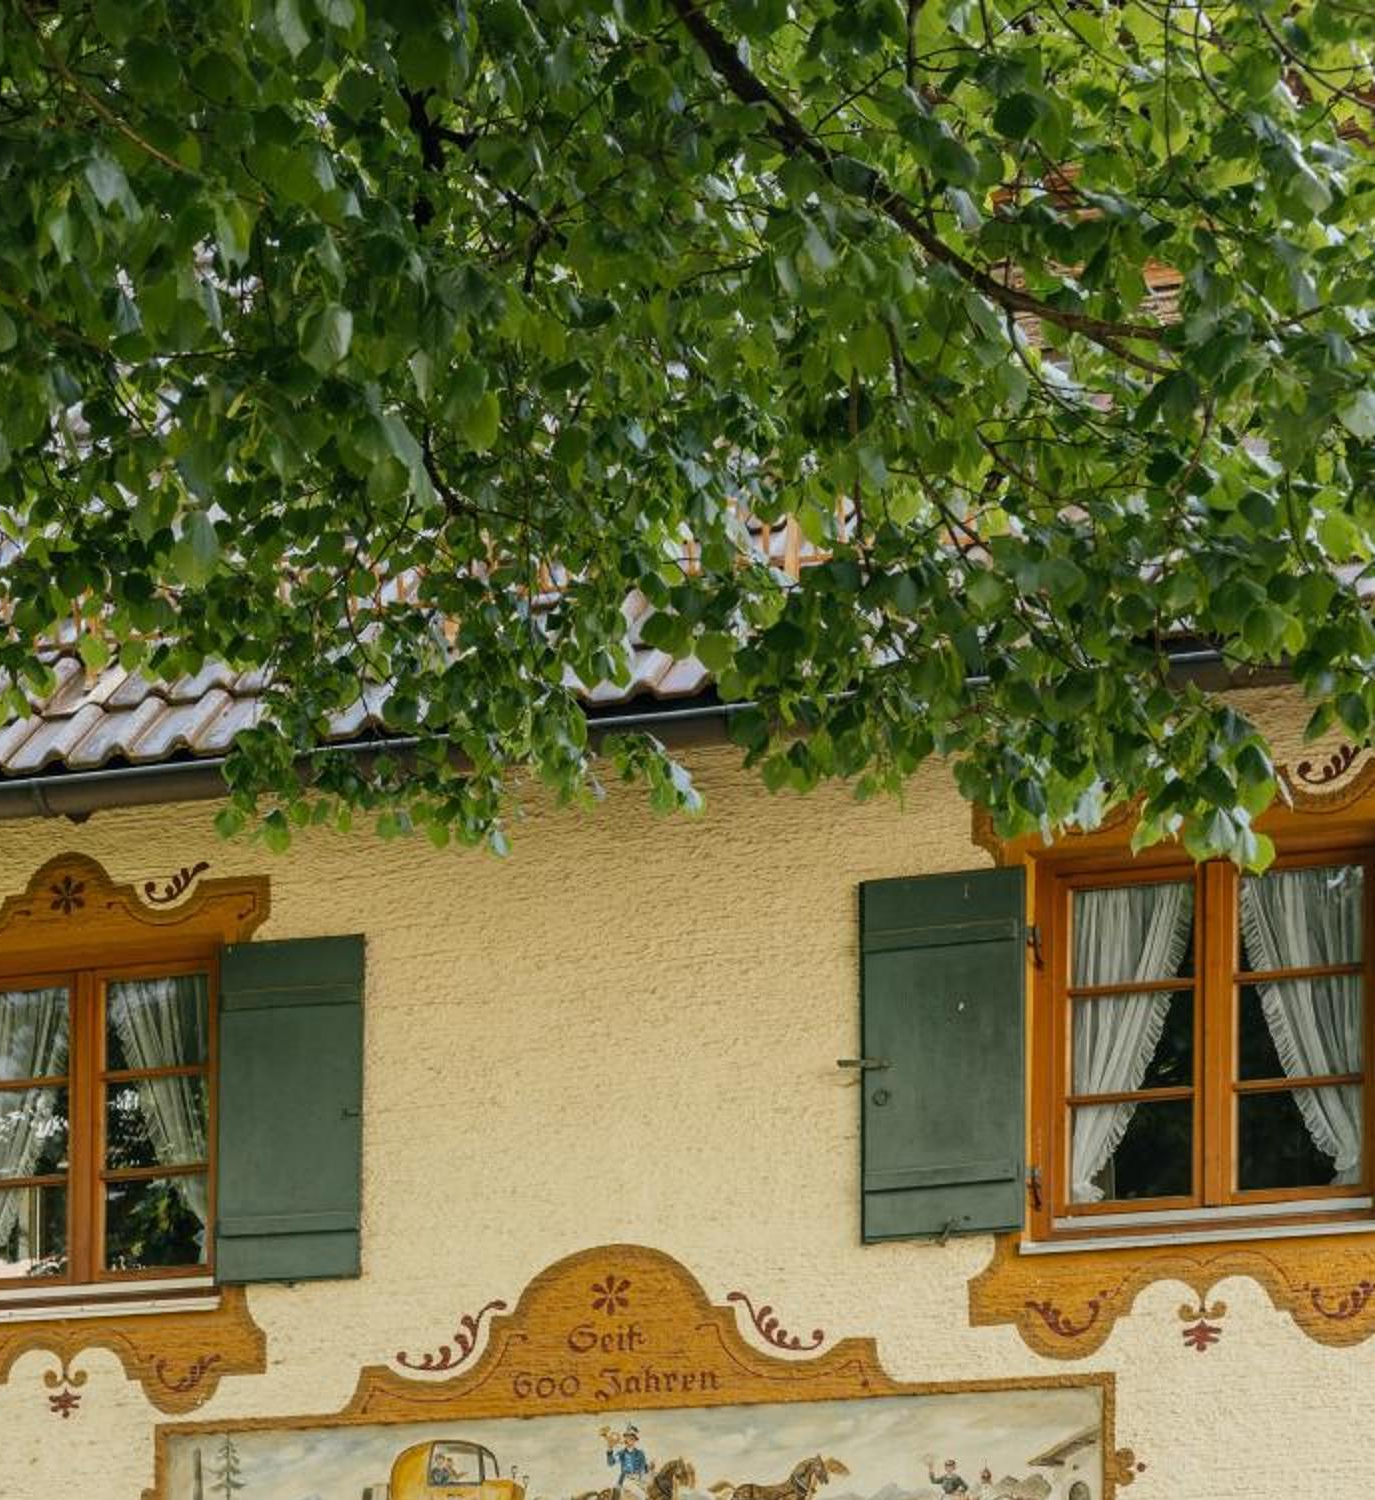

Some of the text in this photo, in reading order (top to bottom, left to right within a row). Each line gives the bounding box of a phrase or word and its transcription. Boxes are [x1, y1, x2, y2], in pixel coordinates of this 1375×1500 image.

[567, 1322, 646, 1353] Seit
[513, 1365, 722, 1401] 600 Jahren
